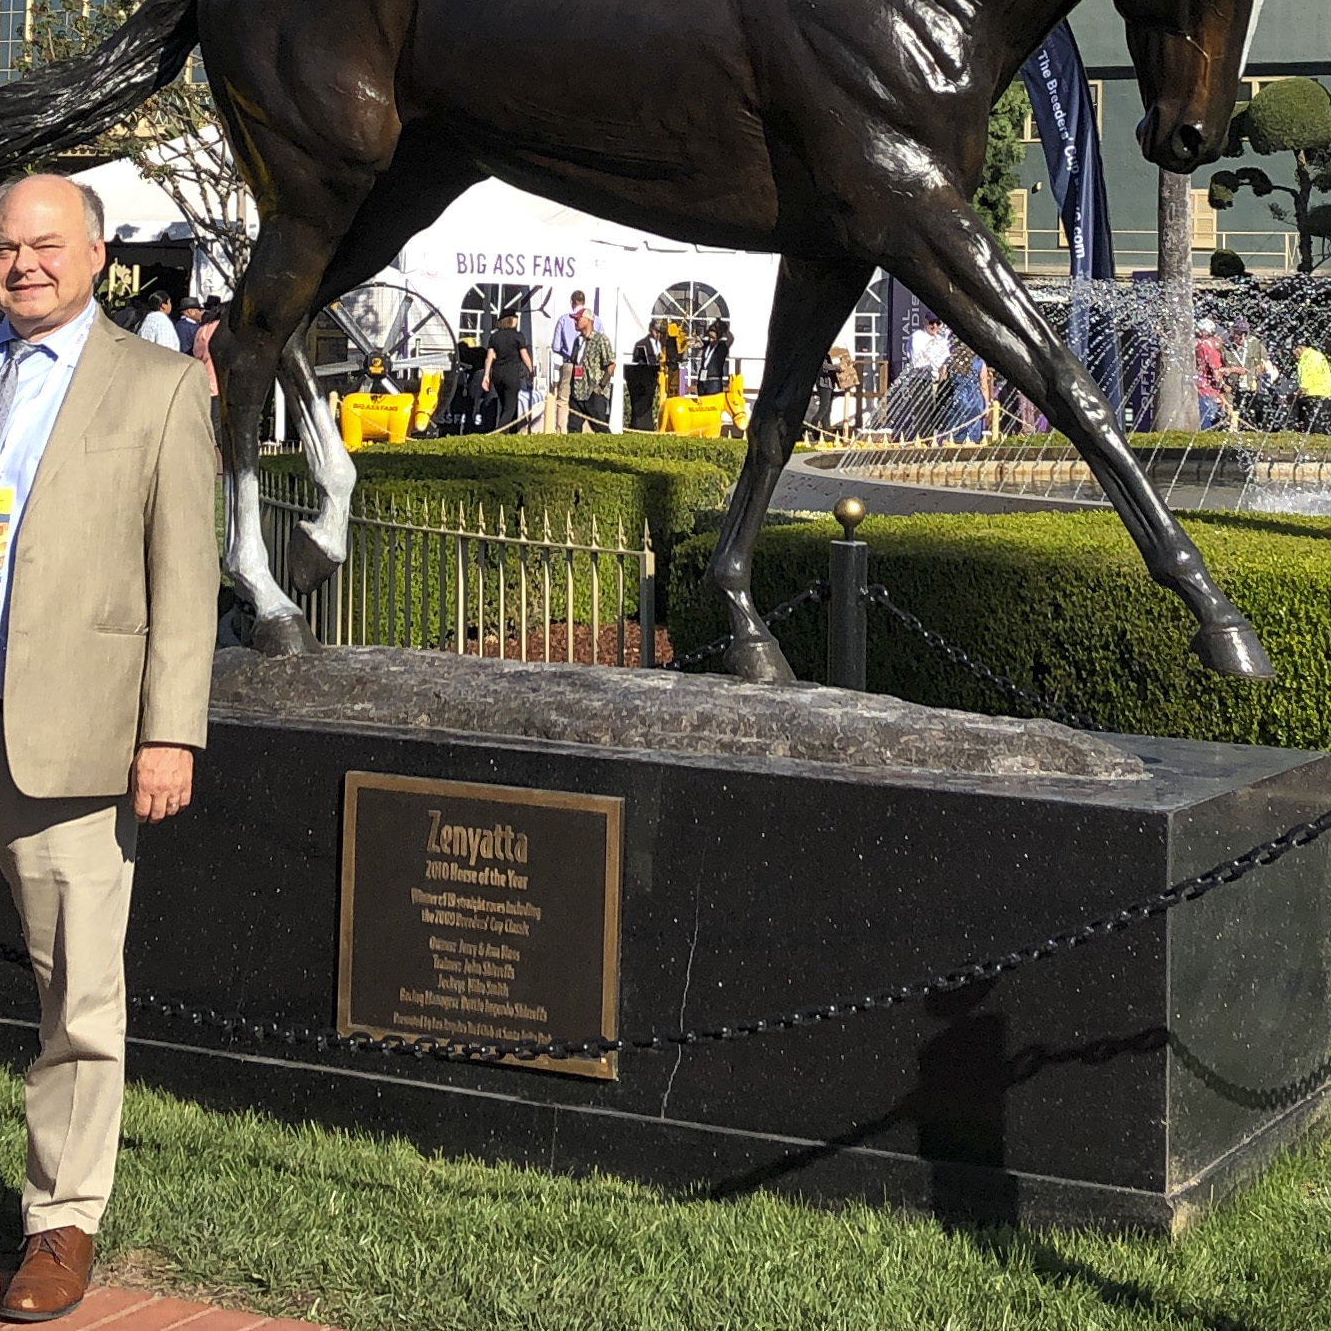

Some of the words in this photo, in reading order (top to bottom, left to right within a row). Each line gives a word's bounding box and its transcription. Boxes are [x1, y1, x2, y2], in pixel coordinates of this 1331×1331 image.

[1037, 50, 1051, 78] The
[1046, 78, 1074, 141] Breeders'
[456, 251, 486, 275] BIG
[493, 253, 526, 276] ASS
[533, 255, 576, 278] FANS
[427, 809, 528, 866] Zenyatta
[426, 859, 450, 880] 2010
[450, 862, 478, 884] Horse
[478, 867, 490, 886] of
[490, 867, 507, 887] the
[507, 868, 529, 890] Year
[411, 887, 437, 905] Winner
[438, 891, 447, 907] of
[447, 892, 456, 908] 19
[457, 895, 486, 913] straight
[486, 901, 505, 914] races
[421, 908, 435, 924] the
[435, 909, 456, 926] 2009
[456, 912, 489, 931] Breeders'
[490, 916, 504, 936] Cup
[504, 918, 530, 937] Classic
[459, 938, 478, 957] Jerry
[478, 942, 485, 957] &
[485, 943, 500, 959] Ann
[433, 954, 462, 973] Trainer:
[463, 958, 482, 976] John
[400, 987, 424, 1008] Racing
[437, 973, 466, 994] Jockey:
[467, 977, 485, 995] Mike
[486, 980, 509, 998] Smith
